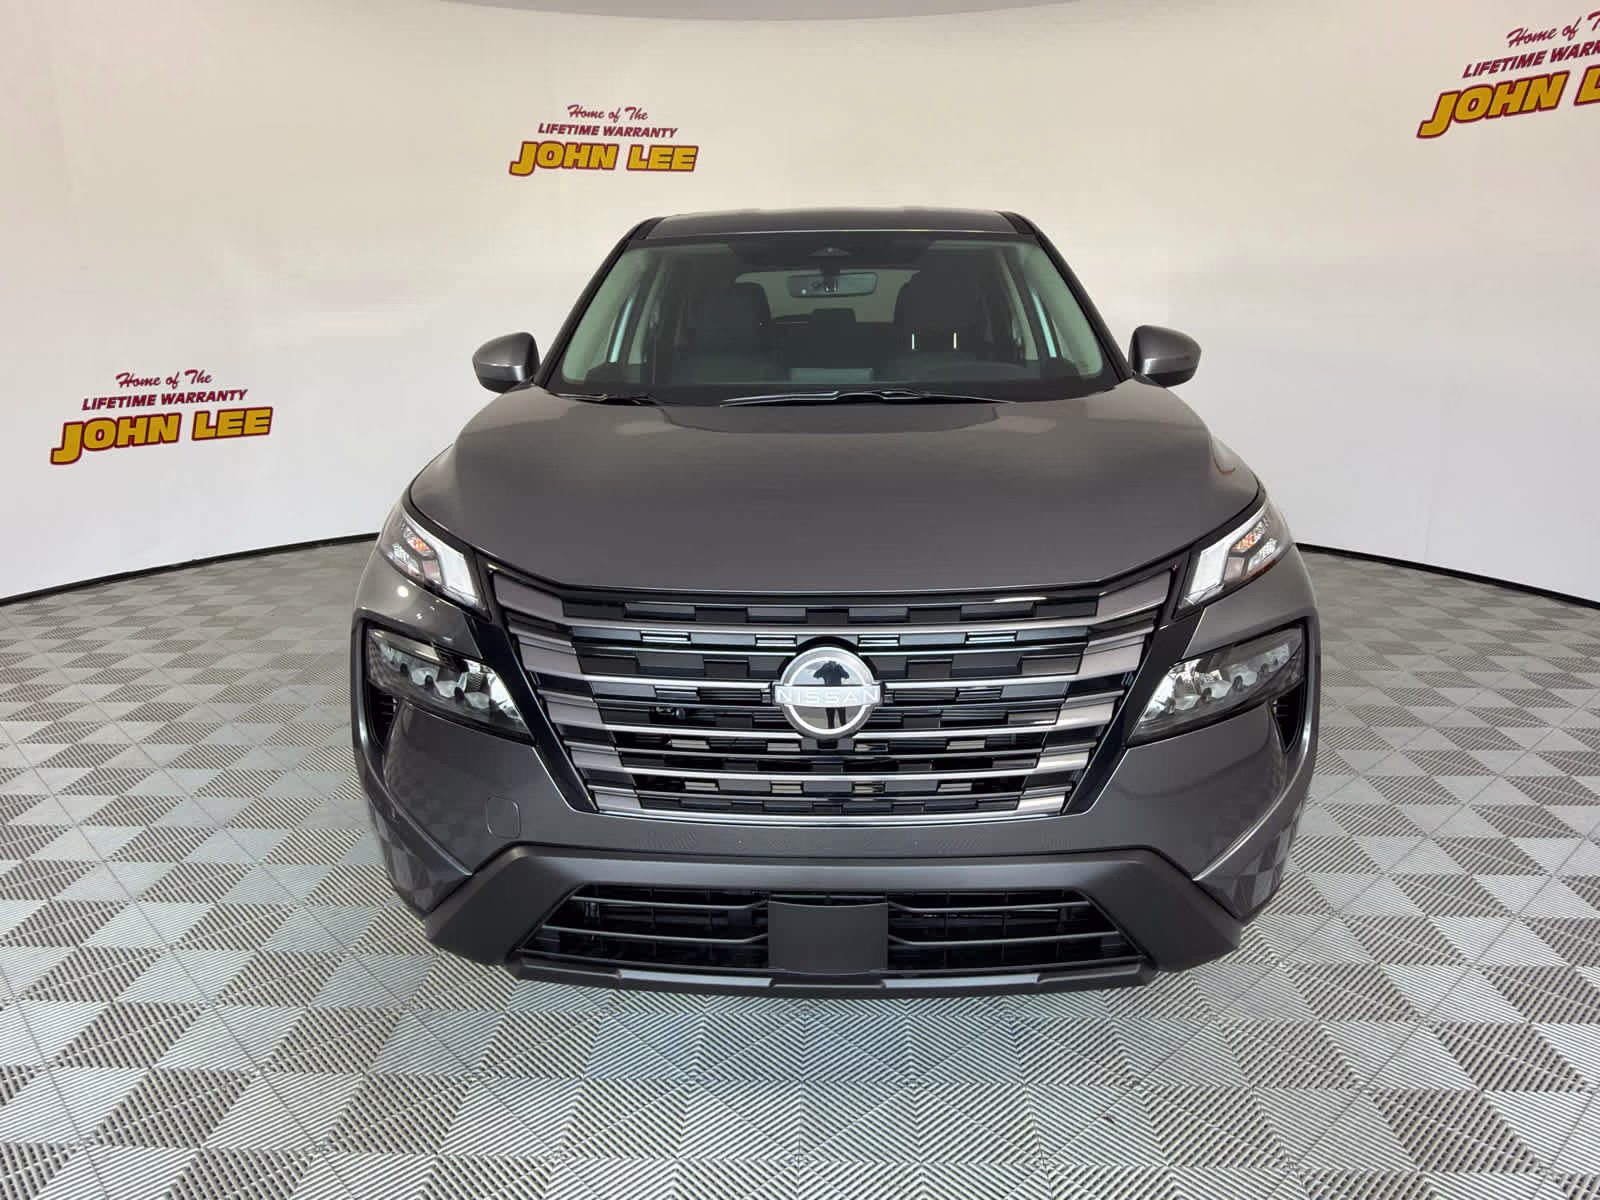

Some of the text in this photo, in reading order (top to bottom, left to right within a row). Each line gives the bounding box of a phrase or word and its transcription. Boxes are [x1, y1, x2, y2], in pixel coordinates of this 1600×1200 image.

[1507, 27, 1557, 48] Home
[1562, 16, 1582, 41] of
[1462, 50, 1547, 78] LIFETIME
[567, 104, 648, 123] Home of The
[1416, 70, 1570, 139] JOHN
[538, 123, 678, 138] LIFETIME WARRANTY
[509, 140, 699, 177] JOHN LEE
[115, 369, 212, 389] Home of The
[82, 389, 248, 410] LIFETIME WARRANTY
[50, 406, 273, 465] JOHN LEE
[777, 686, 879, 704] NISSAN
